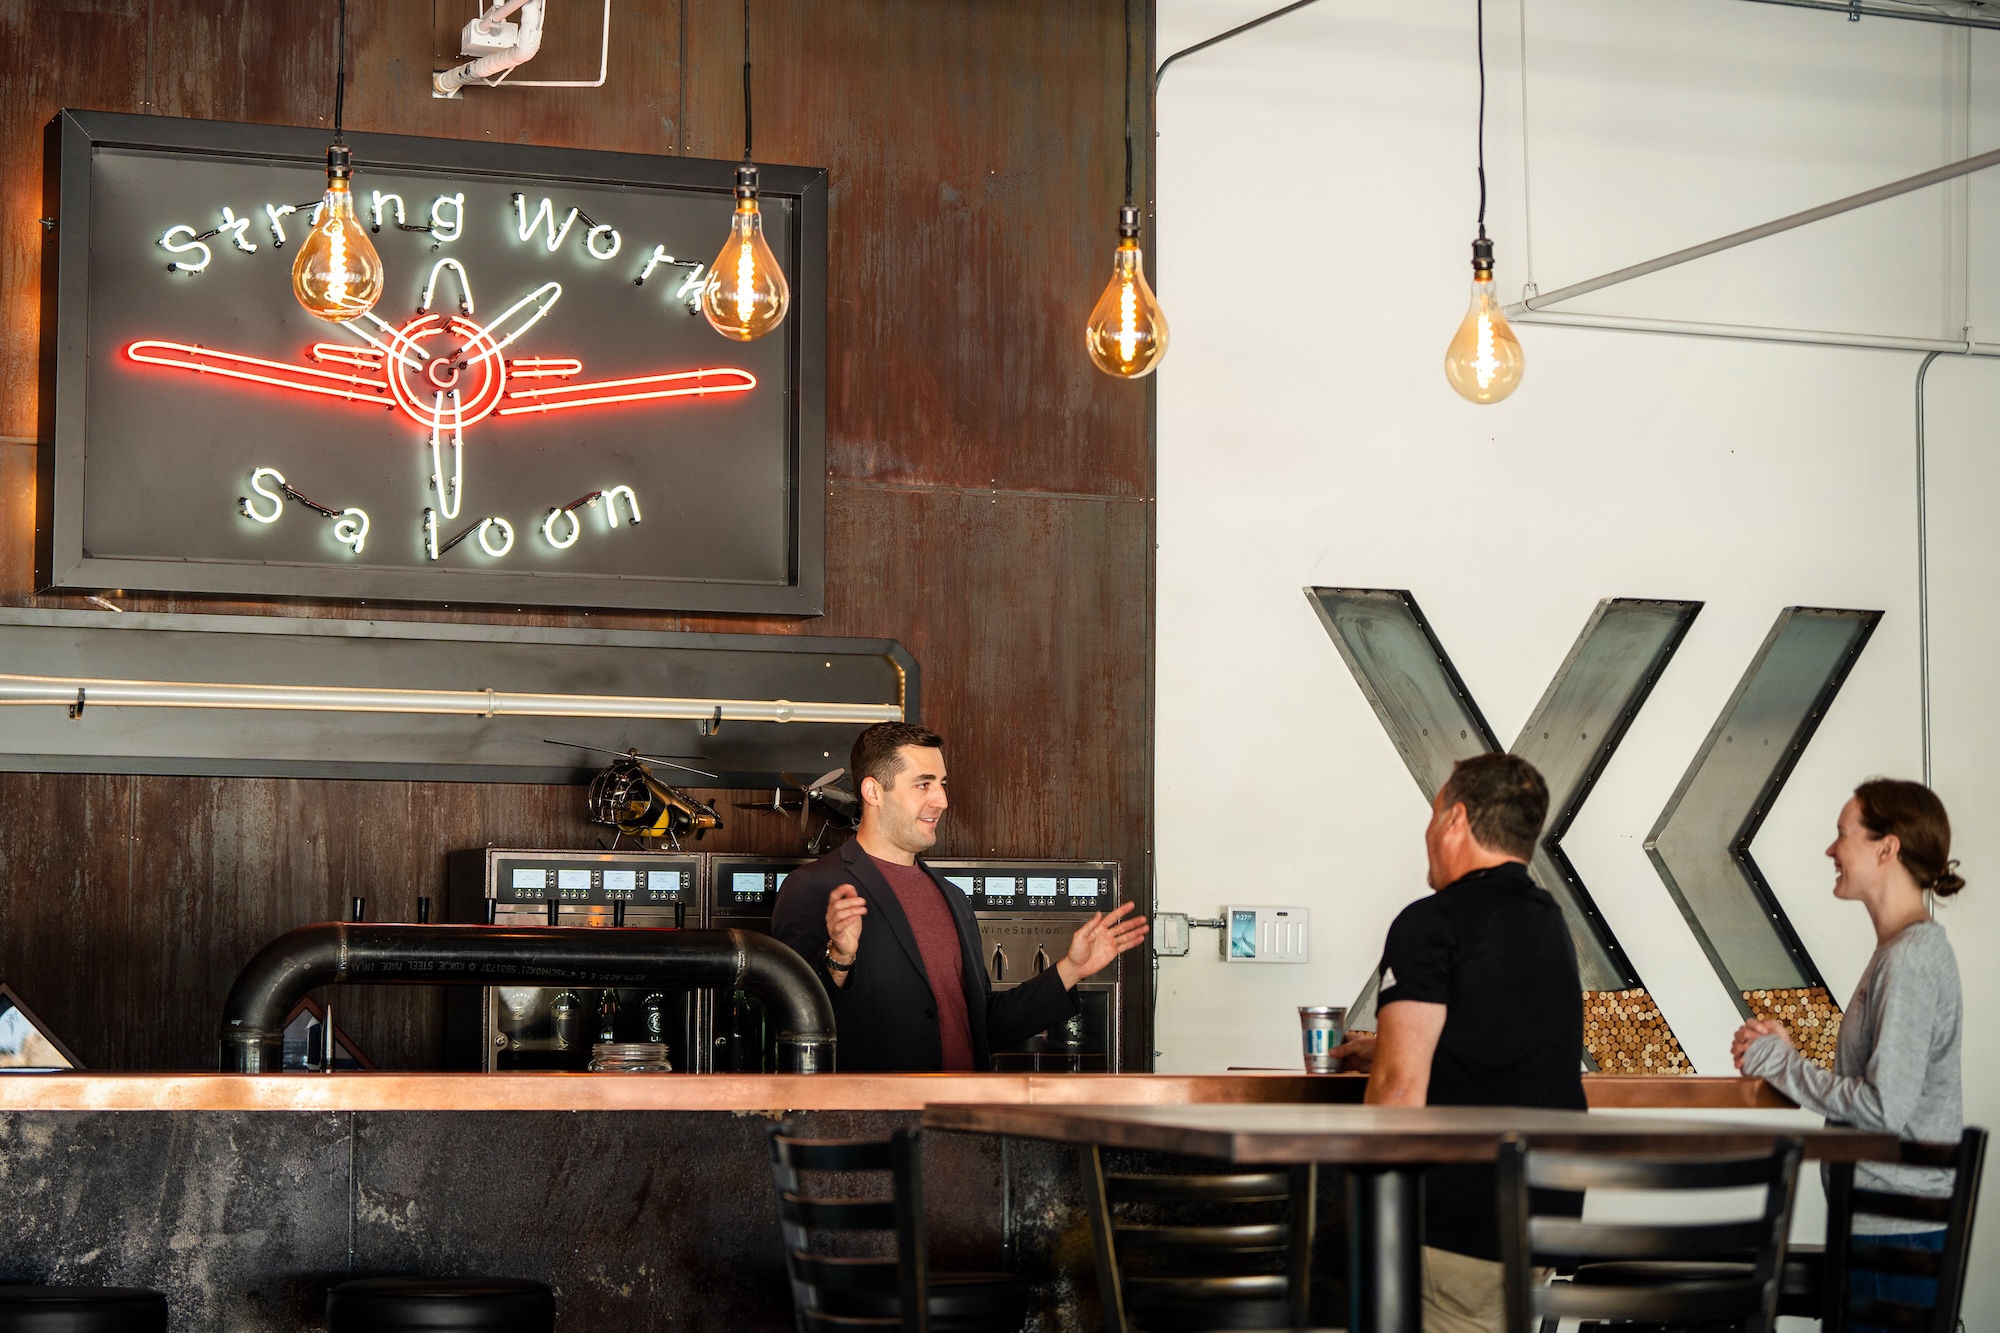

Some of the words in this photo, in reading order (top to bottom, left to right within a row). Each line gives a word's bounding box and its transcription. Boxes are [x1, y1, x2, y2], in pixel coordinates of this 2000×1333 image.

[161, 189, 467, 273] Strng
[243, 466, 643, 561] Saloon
[381, 961, 403, 972] MADE
[407, 960, 434, 971] STEEL
[438, 960, 466, 972] KUKJE
